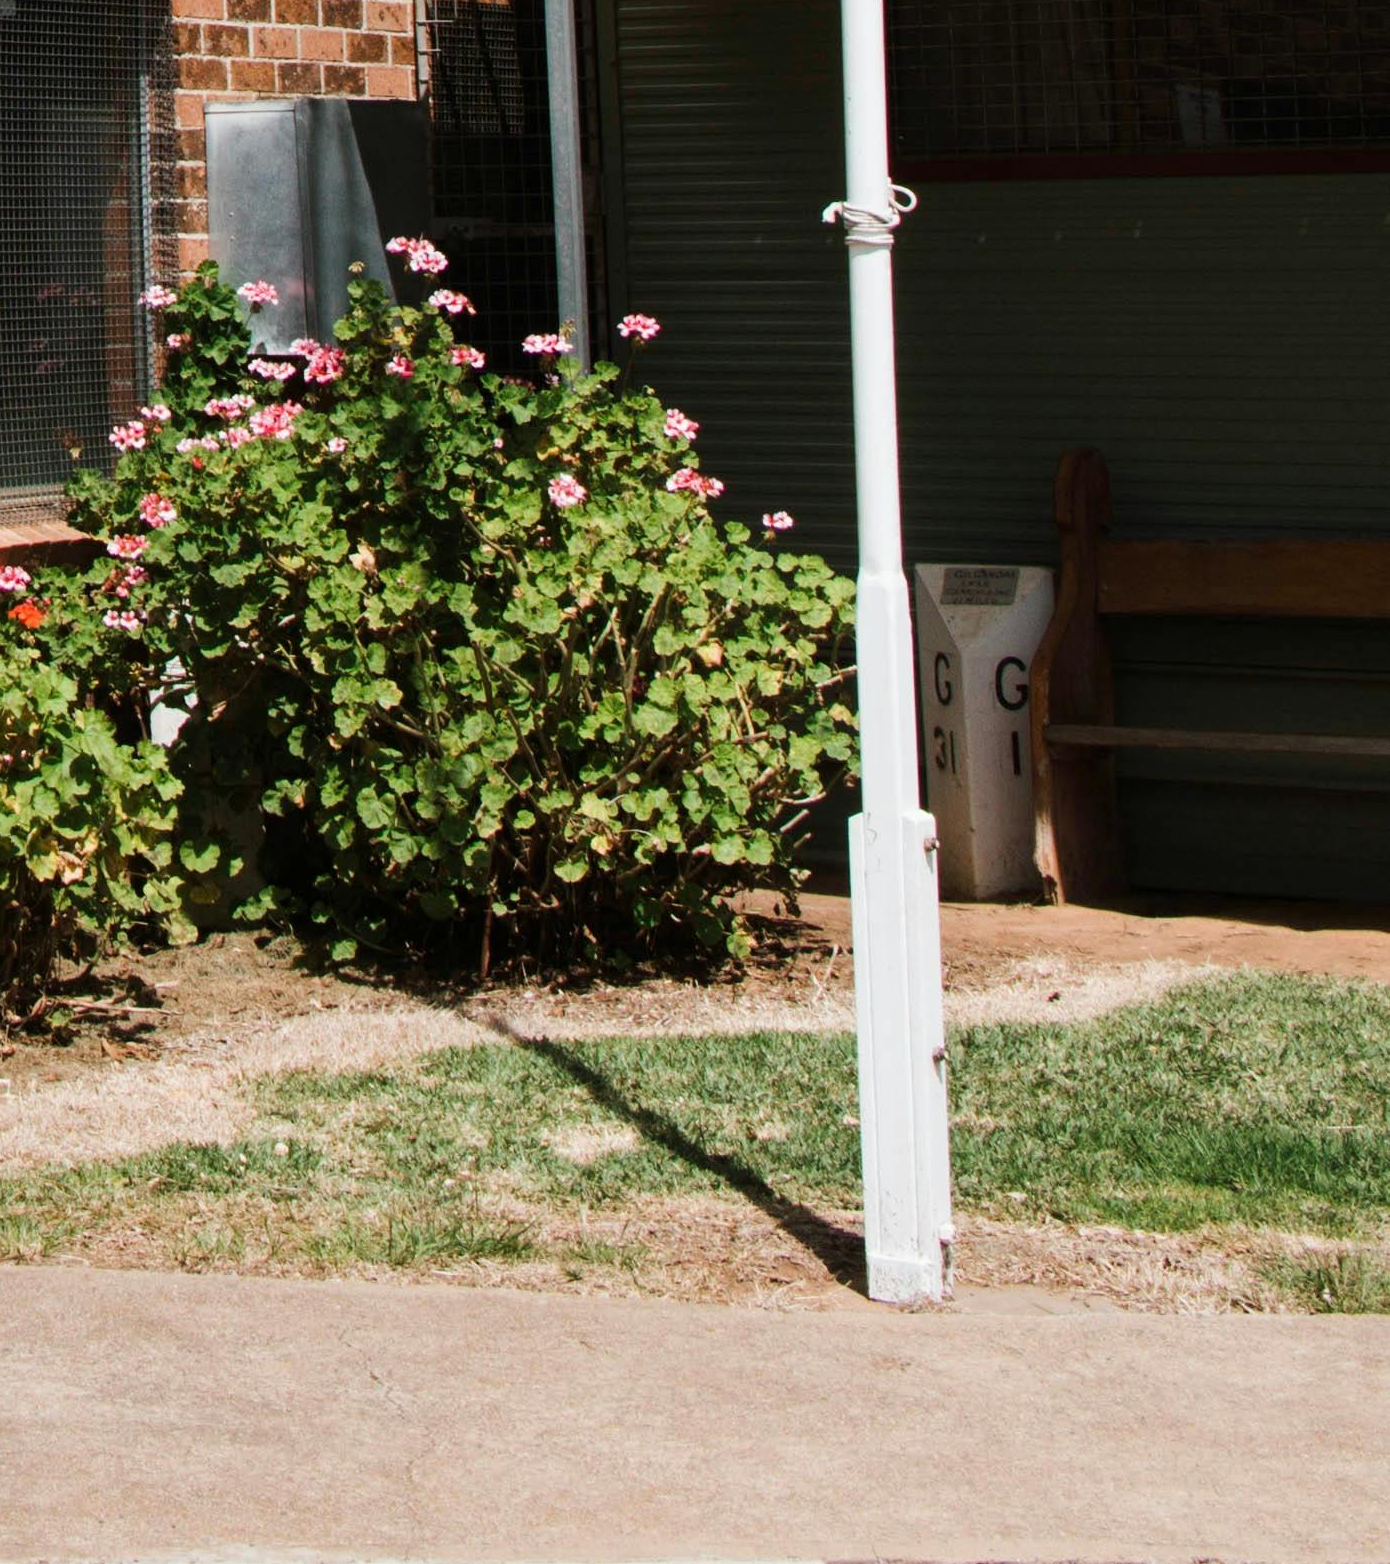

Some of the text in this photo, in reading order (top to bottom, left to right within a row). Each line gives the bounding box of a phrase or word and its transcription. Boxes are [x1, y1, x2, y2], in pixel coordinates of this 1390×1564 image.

[934, 652, 953, 706] G
[995, 657, 1029, 711] G
[934, 726, 956, 774] 31
